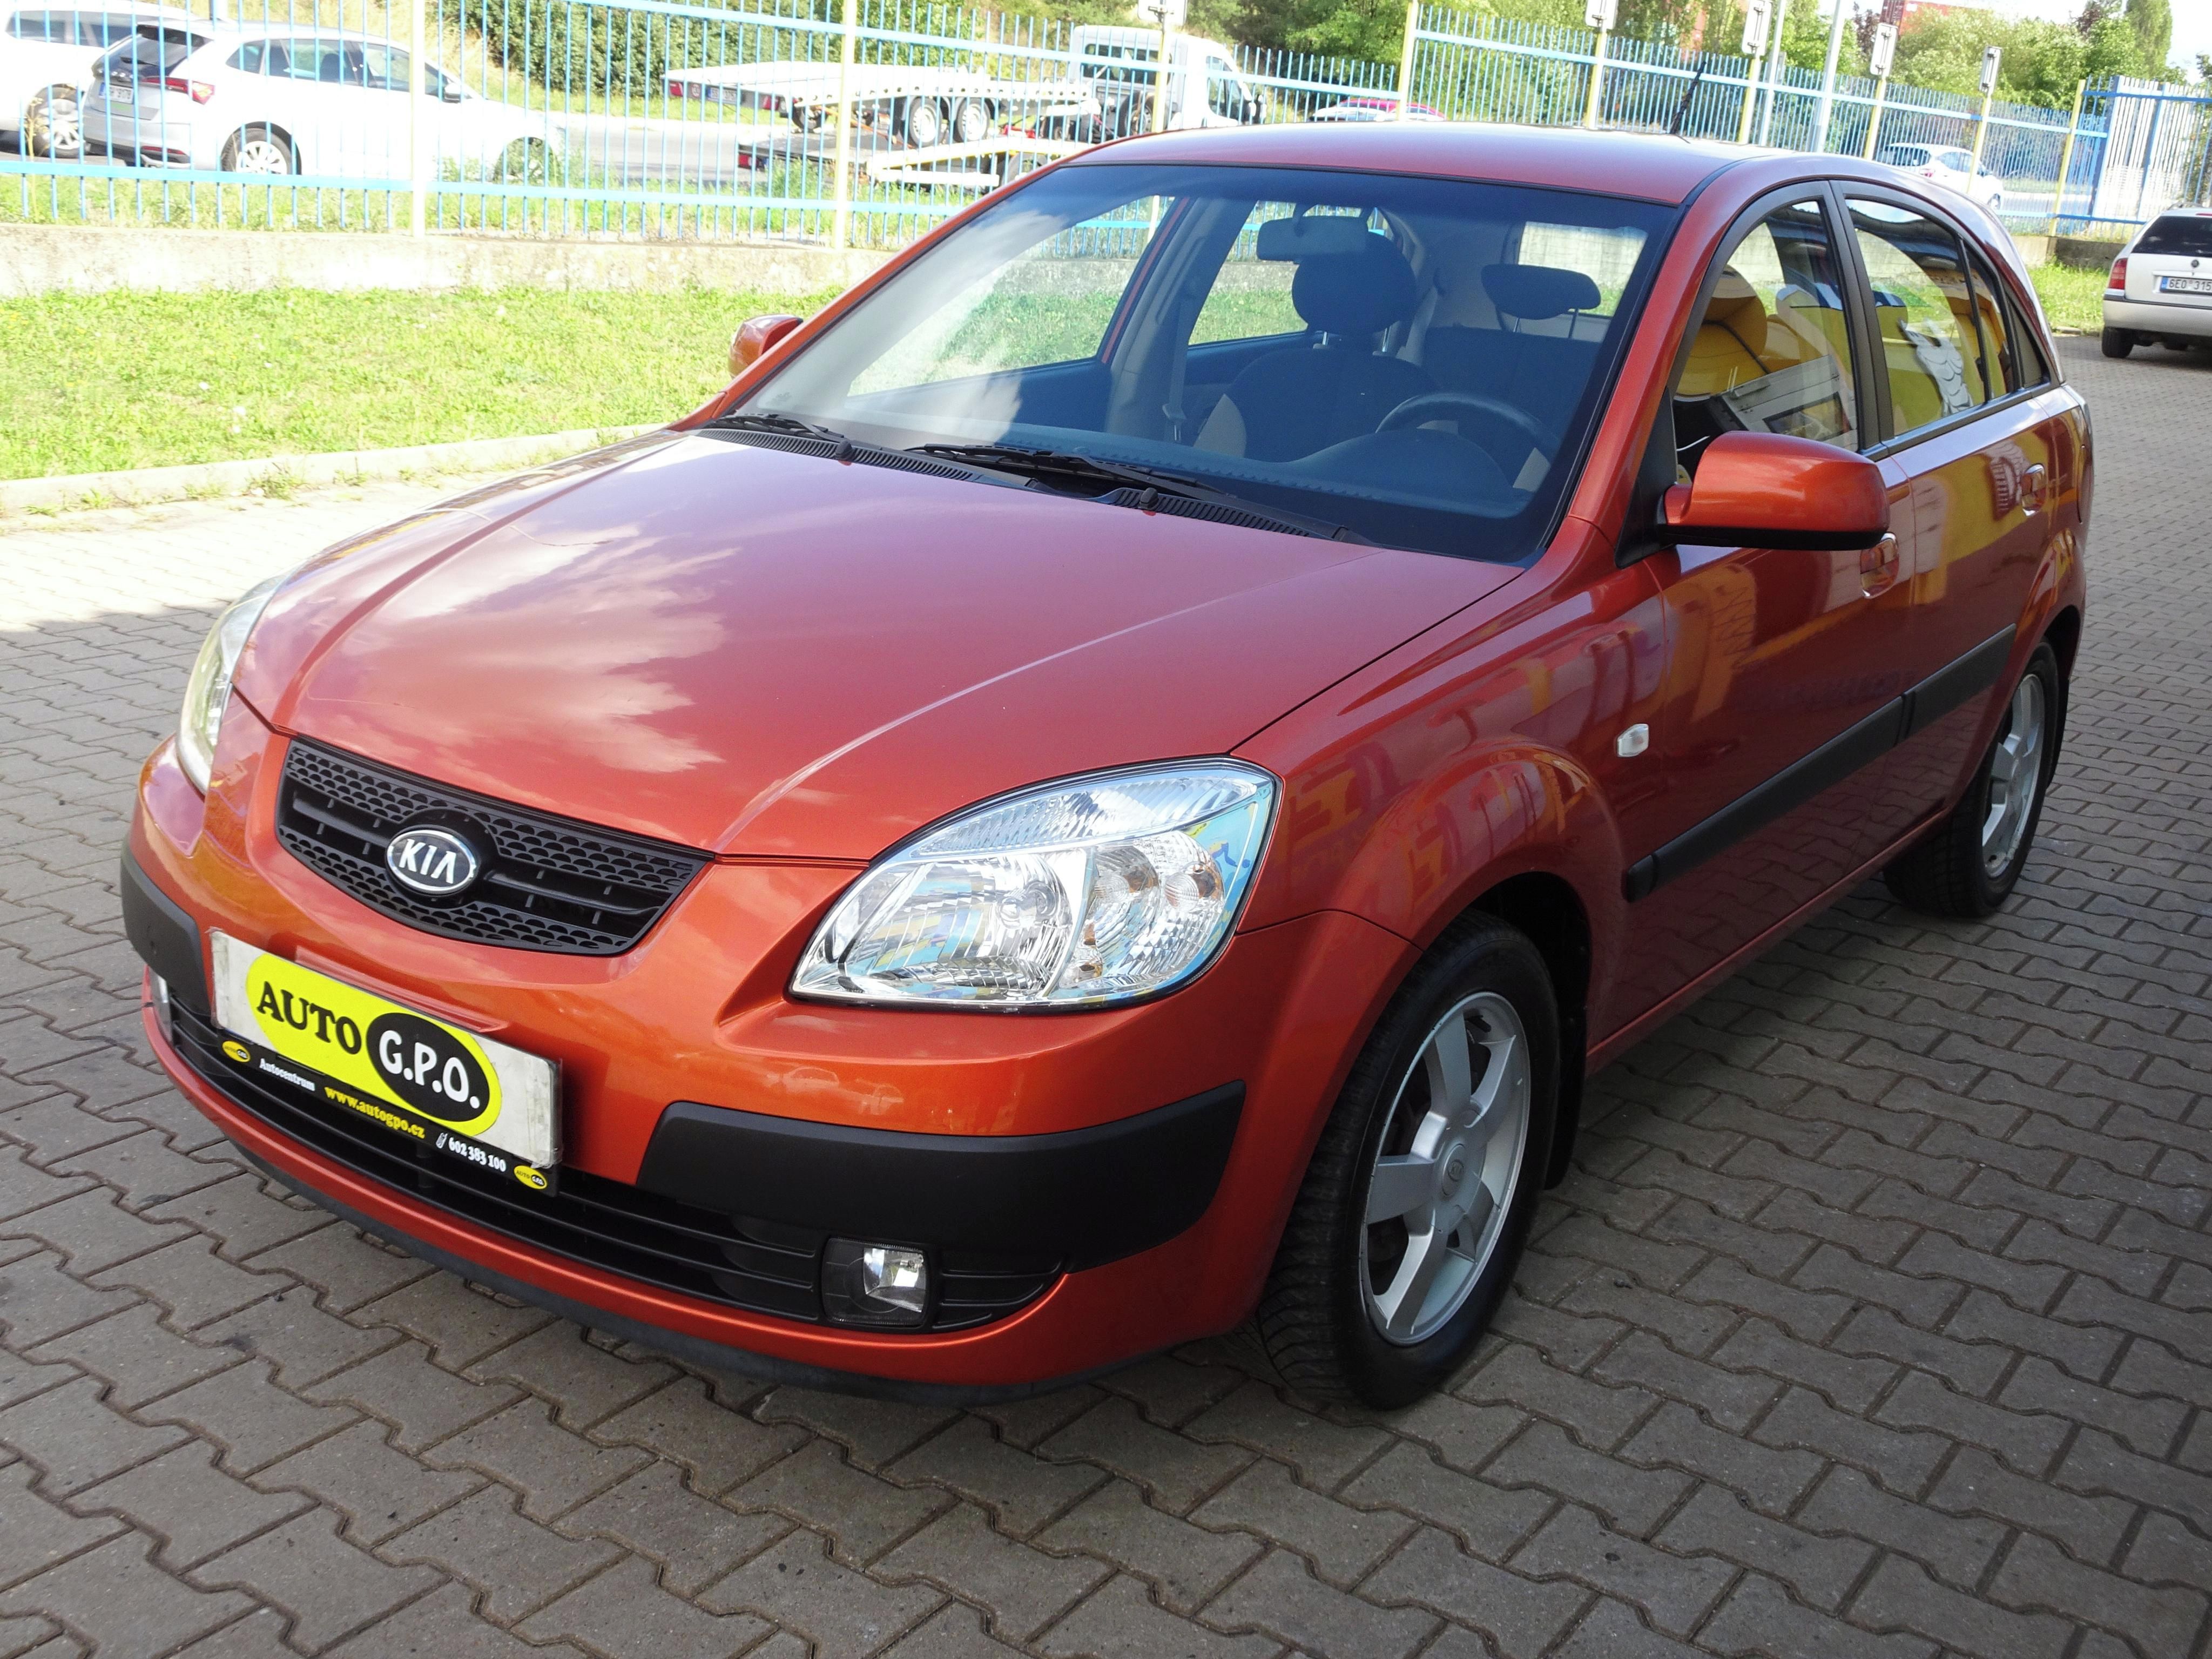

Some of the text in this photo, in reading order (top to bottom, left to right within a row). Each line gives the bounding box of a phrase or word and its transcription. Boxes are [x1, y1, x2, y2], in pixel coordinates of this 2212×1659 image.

[399, 838, 457, 884] KIA
[257, 981, 480, 1109] AUTO G.P.O.
[259, 1058, 315, 1091] Autocentrum
[324, 1087, 425, 1139] www.autogpo.cz
[448, 1137, 507, 1172] 602 383 100
[516, 1170, 530, 1179] AUTO
